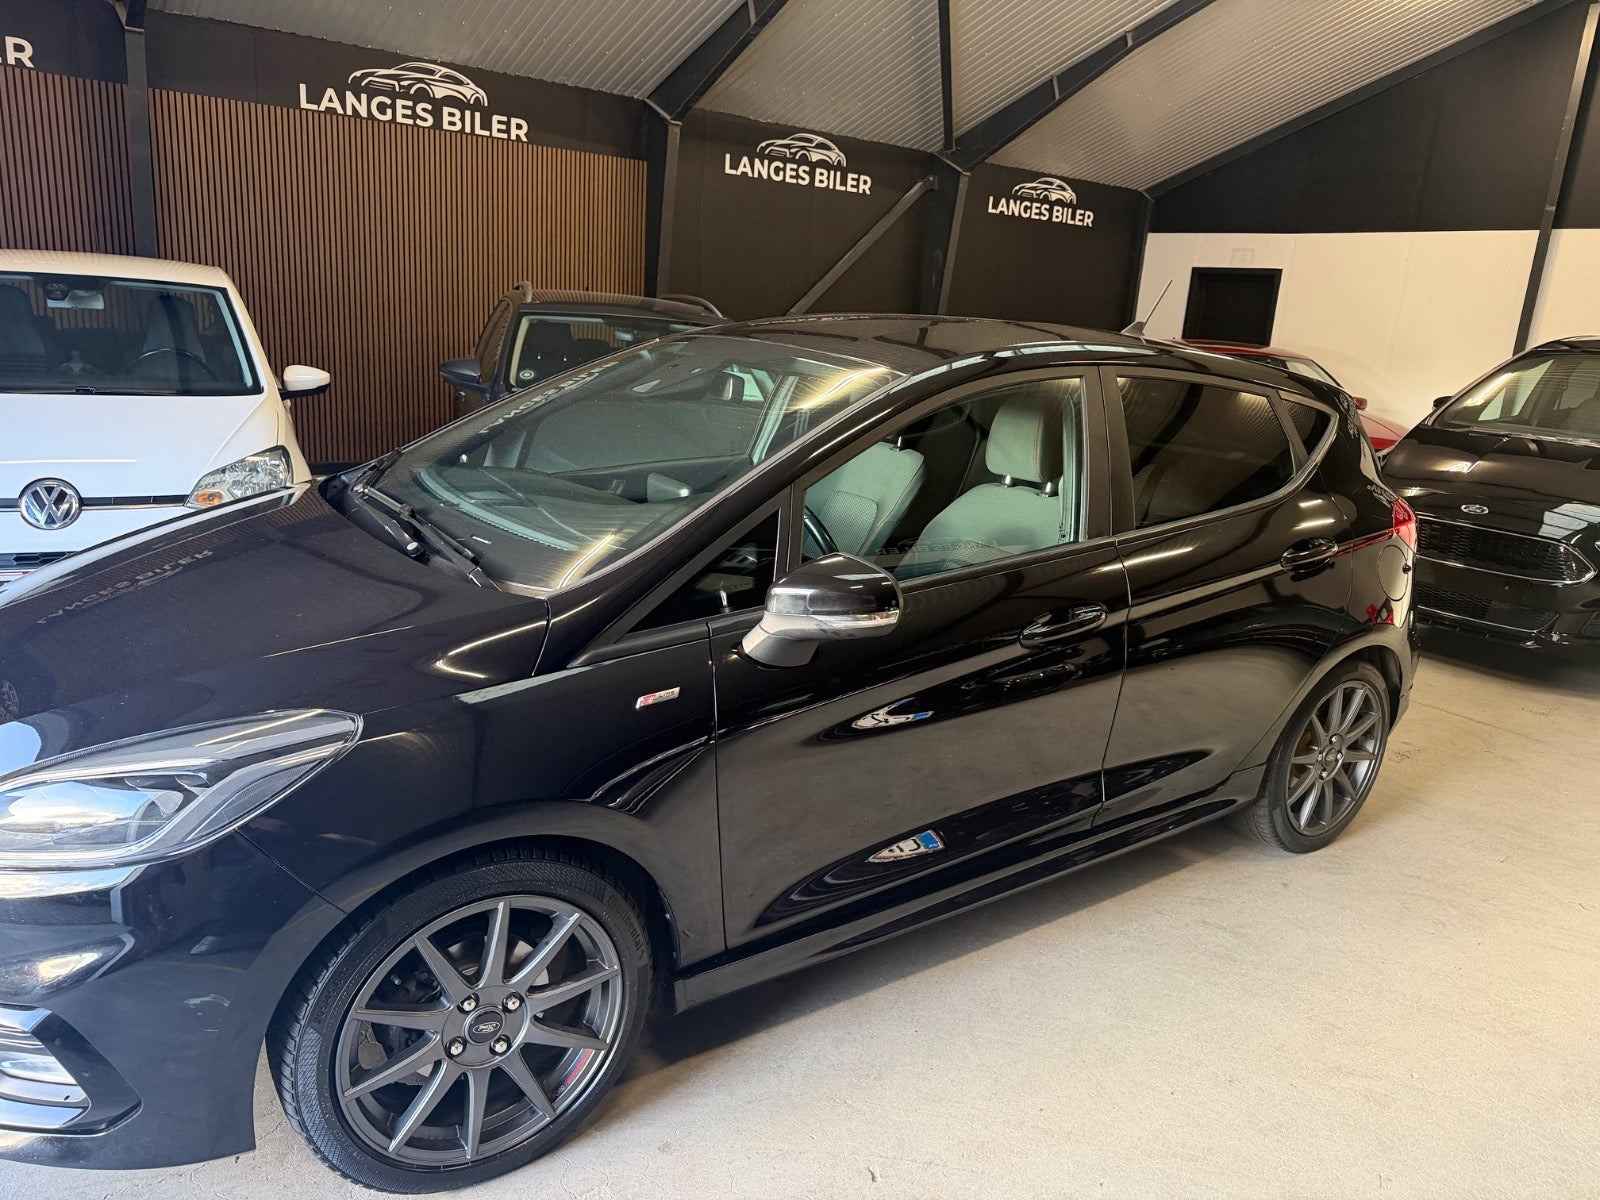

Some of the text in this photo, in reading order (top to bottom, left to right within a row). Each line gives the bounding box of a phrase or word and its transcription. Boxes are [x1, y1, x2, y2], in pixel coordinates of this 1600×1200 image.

[0, 35, 35, 68] R
[299, 83, 529, 142] LANGES BILER
[724, 153, 872, 195] LANGES BILER
[987, 195, 1094, 227] LANGES BILER
